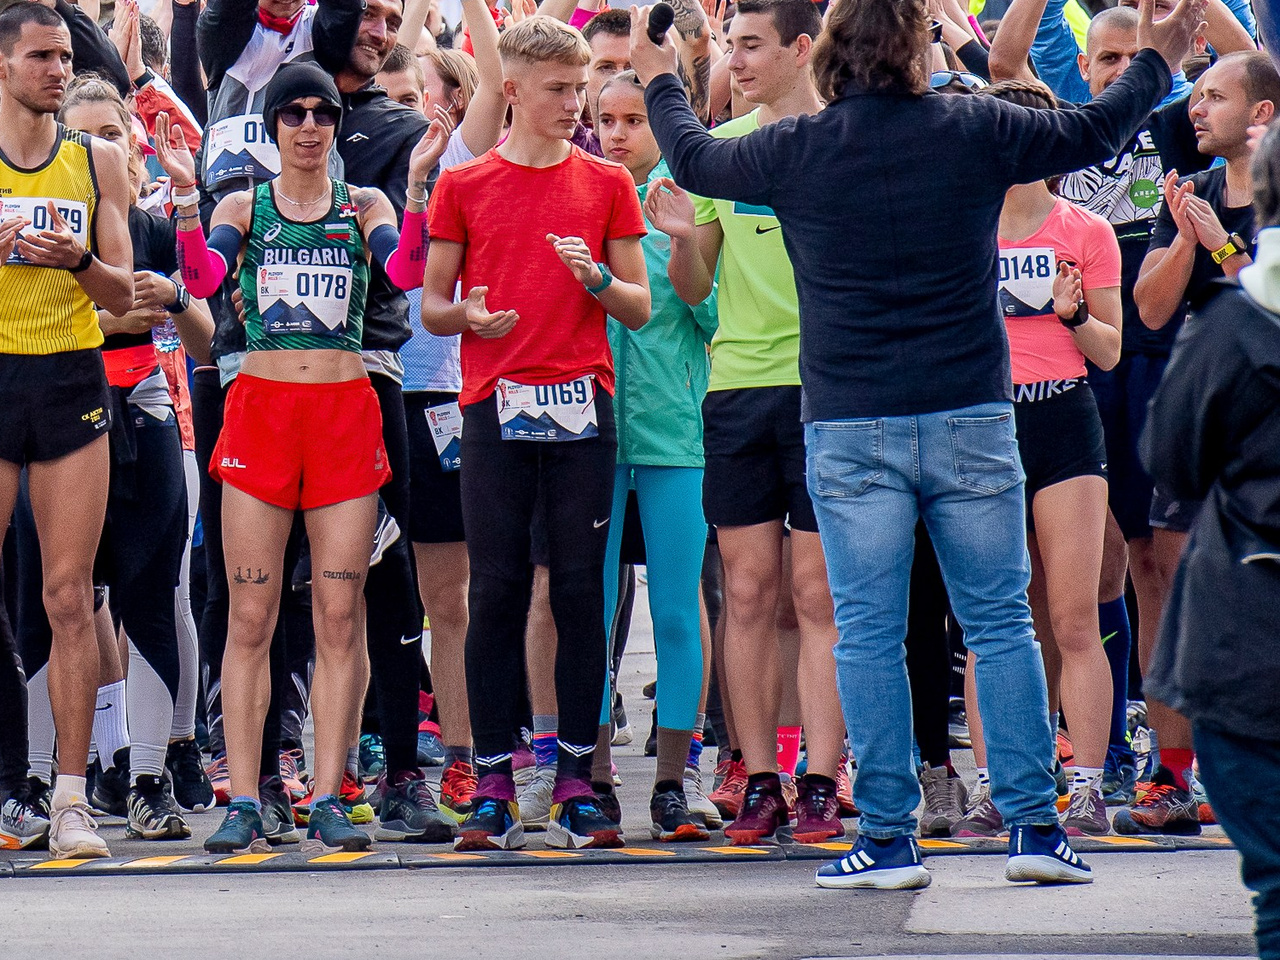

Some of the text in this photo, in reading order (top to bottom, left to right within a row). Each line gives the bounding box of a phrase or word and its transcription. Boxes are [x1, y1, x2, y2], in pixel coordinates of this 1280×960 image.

[263, 248, 350, 266] BULGARIA
[999, 254, 1051, 281] 0148
[296, 272, 347, 300] 0178
[534, 380, 587, 406] 0169
[1016, 378, 1079, 403] NIKE
